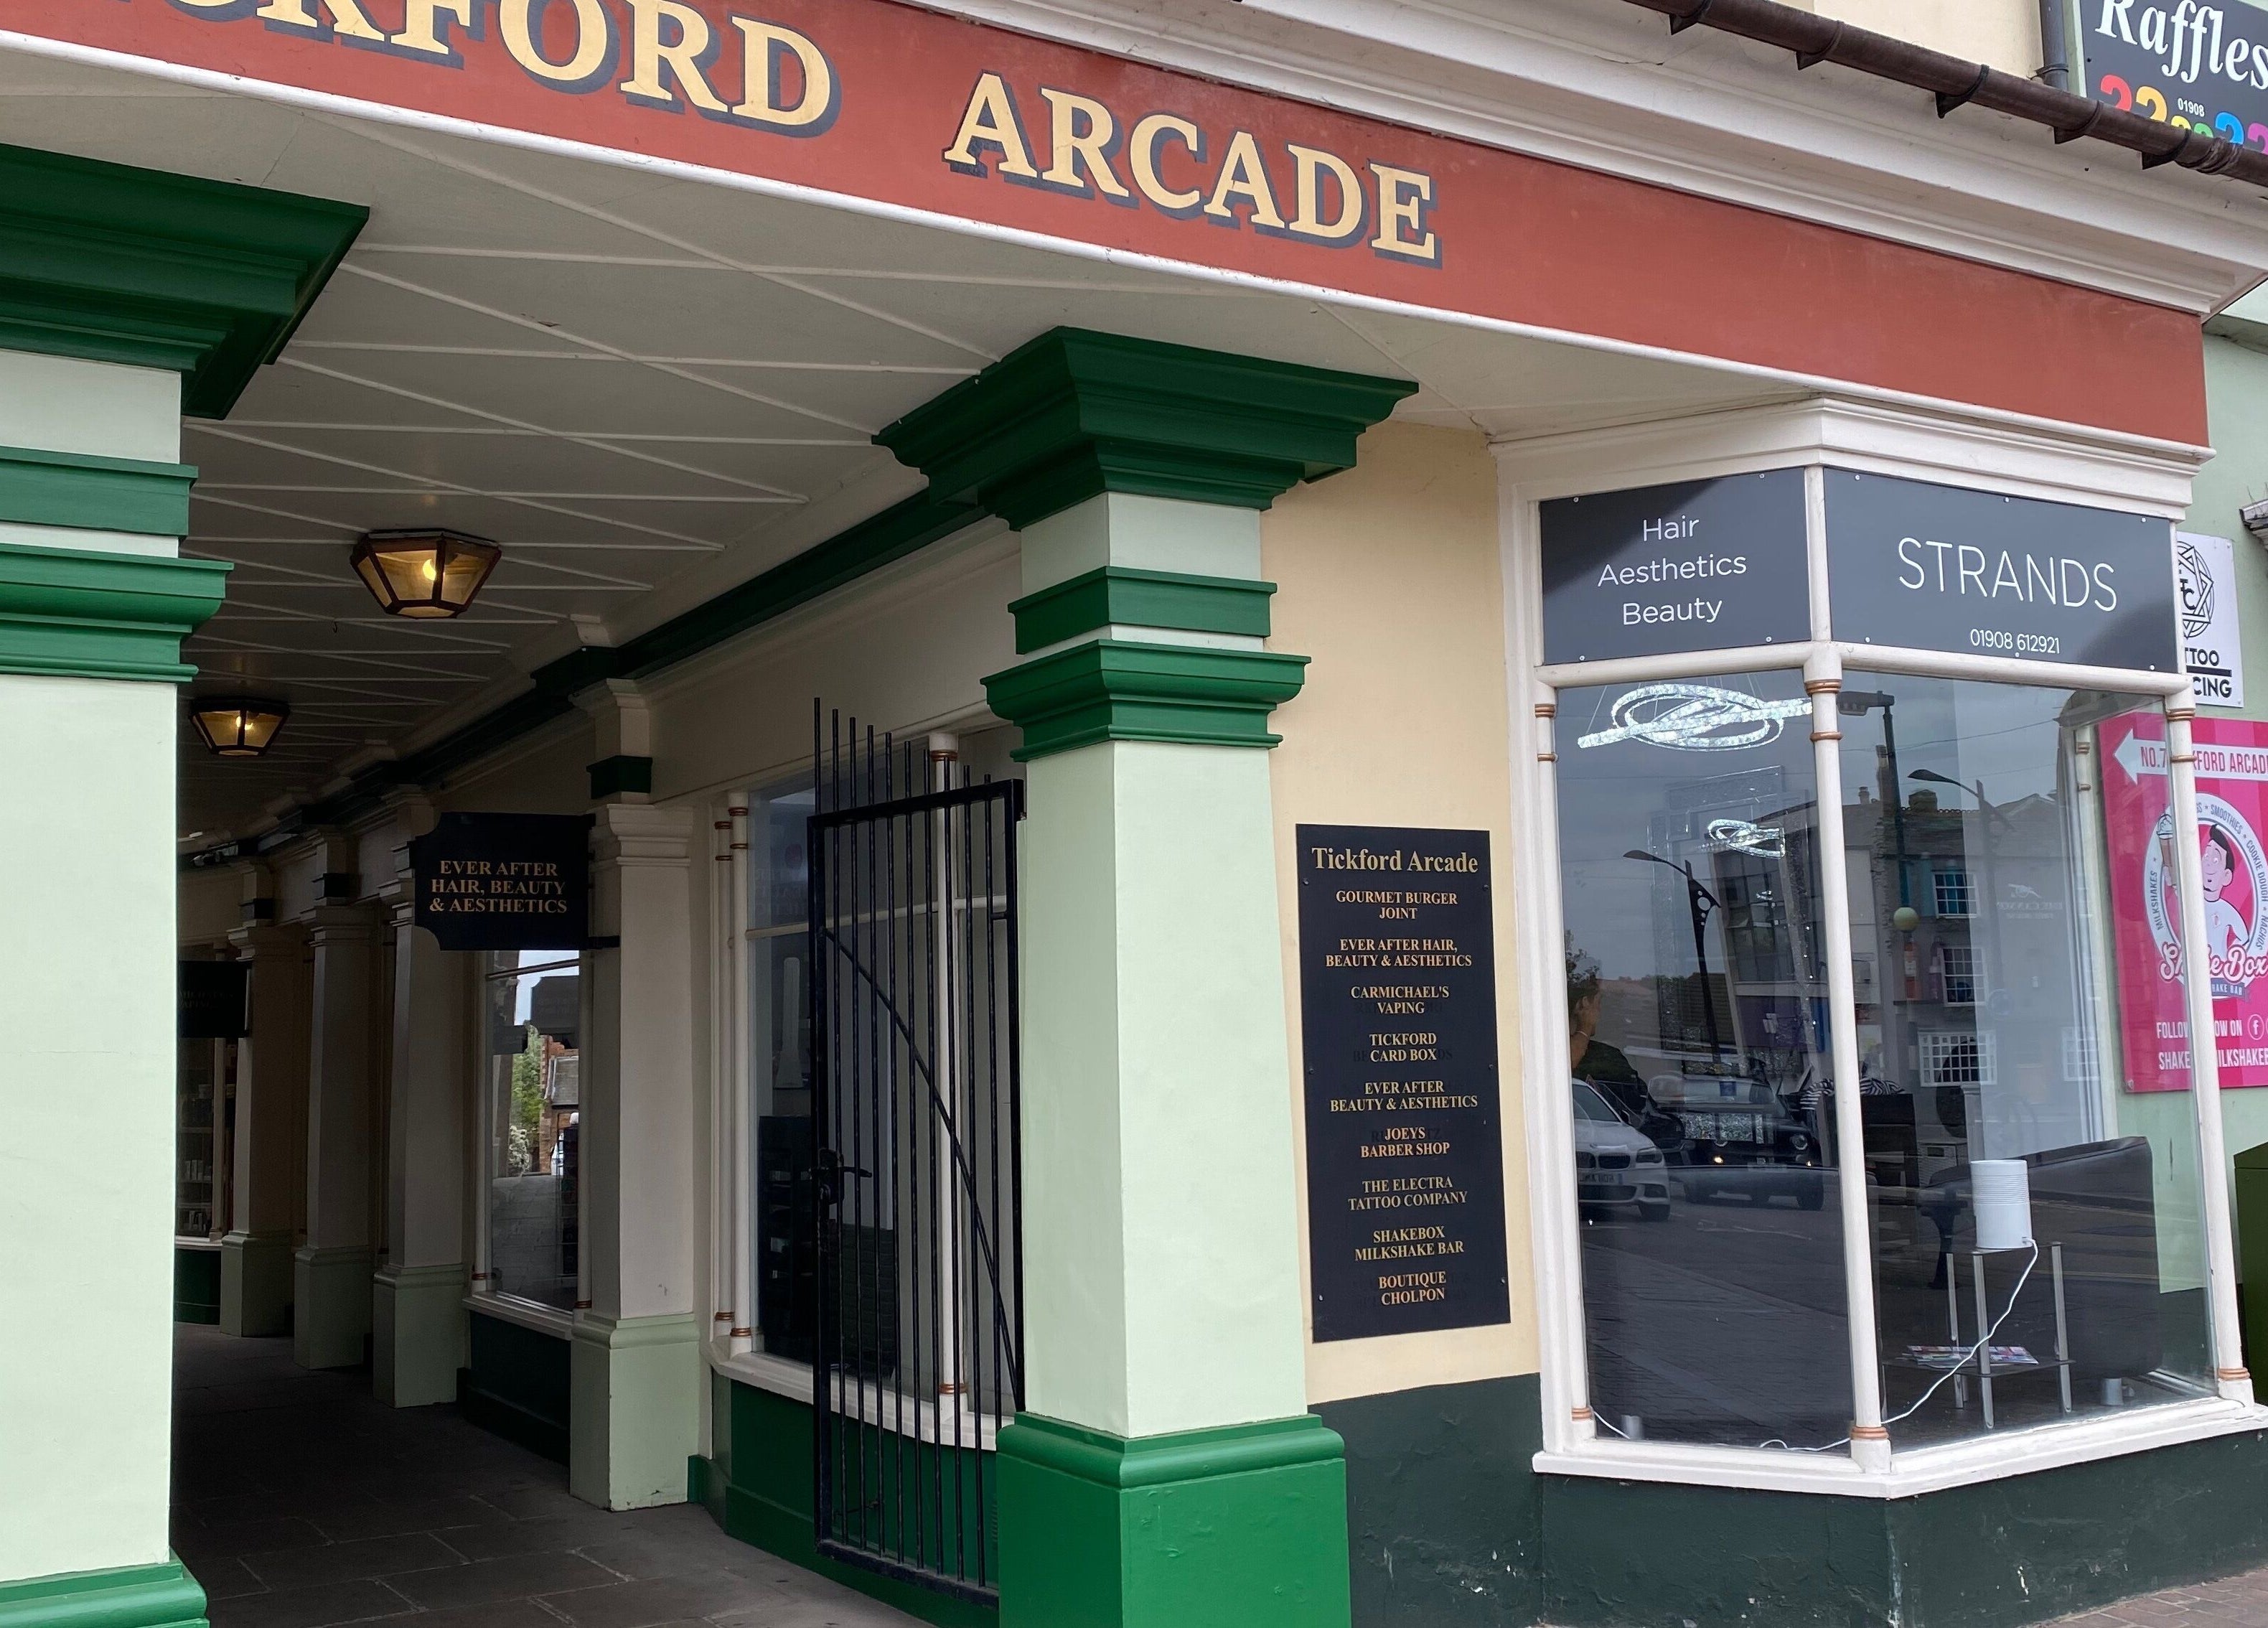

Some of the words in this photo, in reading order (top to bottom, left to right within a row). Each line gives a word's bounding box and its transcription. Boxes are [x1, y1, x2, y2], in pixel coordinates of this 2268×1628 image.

[2095, 0, 2268, 89] Raffles
[2178, 98, 2205, 117] 01908
[943, 70, 1440, 266] ARCADE
[1642, 516, 1700, 543] Hair
[1597, 552, 1747, 588] Aesthetics
[1897, 537, 2117, 613] STRANDS
[1621, 597, 1723, 627] Beauty
[1969, 630, 2013, 650] 01908
[2017, 632, 2061, 655] 612921
[2140, 747, 2166, 767] NO.7
[2230, 752, 2268, 775] ARCAD
[2211, 804, 2242, 835] SMOOTHIES
[440, 861, 491, 874] EVER
[496, 862, 558, 876] AFTER
[1312, 848, 1402, 871] Tickford
[1407, 851, 1479, 873] Arcade
[2246, 840, 2262, 871] COOKIE
[2257, 872, 2268, 902] DOUGH
[431, 879, 485, 895] HAIR,
[491, 880, 566, 894] BEAUTY
[429, 898, 445, 912] &
[449, 899, 567, 913] AESTHETICS
[1336, 891, 1402, 904] GOURMET
[1405, 892, 1458, 904] BURGER
[2150, 871, 2164, 930] MILKSHAKES
[1379, 907, 1418, 920] JOINT
[2256, 914, 2268, 950] NACHOS
[1340, 939, 1375, 950] EVER
[1377, 939, 1420, 950] AFTER
[1423, 939, 1458, 953] HAIR,
[1326, 955, 1378, 967] BEAUTY
[1381, 955, 1392, 966] &
[1394, 955, 1472, 966] AESTHETICS
[2223, 944, 2268, 984] Box
[1351, 986, 1450, 998] CARMICHAEL'S
[1377, 1002, 1425, 1014] VAPING
[2230, 1019, 2243, 1037] ON
[1369, 1034, 1437, 1046] TICKFORD
[1370, 1049, 1407, 1062] CARD
[1410, 1049, 1437, 1060] BOX
[1365, 1082, 1400, 1095] EVER
[1402, 1081, 1444, 1094] AFTER
[1331, 1098, 1384, 1112] BEAUTY
[1386, 1098, 1397, 1110] &
[1400, 1095, 1478, 1109] AESTHETICS
[1384, 1127, 1425, 1141] JOEYS
[1361, 1143, 1415, 1158] BARBER
[1416, 1143, 1450, 1156] SHOP
[1362, 1179, 1390, 1193] THE
[1393, 1176, 1453, 1192] ELECTRA
[1348, 1196, 1401, 1210] TATTOO
[1403, 1191, 1468, 1207] COMPANY
[1373, 1226, 1445, 1243] SHAKEBOX
[1355, 1243, 1435, 1261] MILKSHAKE
[1438, 1241, 1464, 1254] BAR
[1379, 1271, 1447, 1289] BOUTIQUE
[1381, 1288, 1445, 1306] CHOLPON
